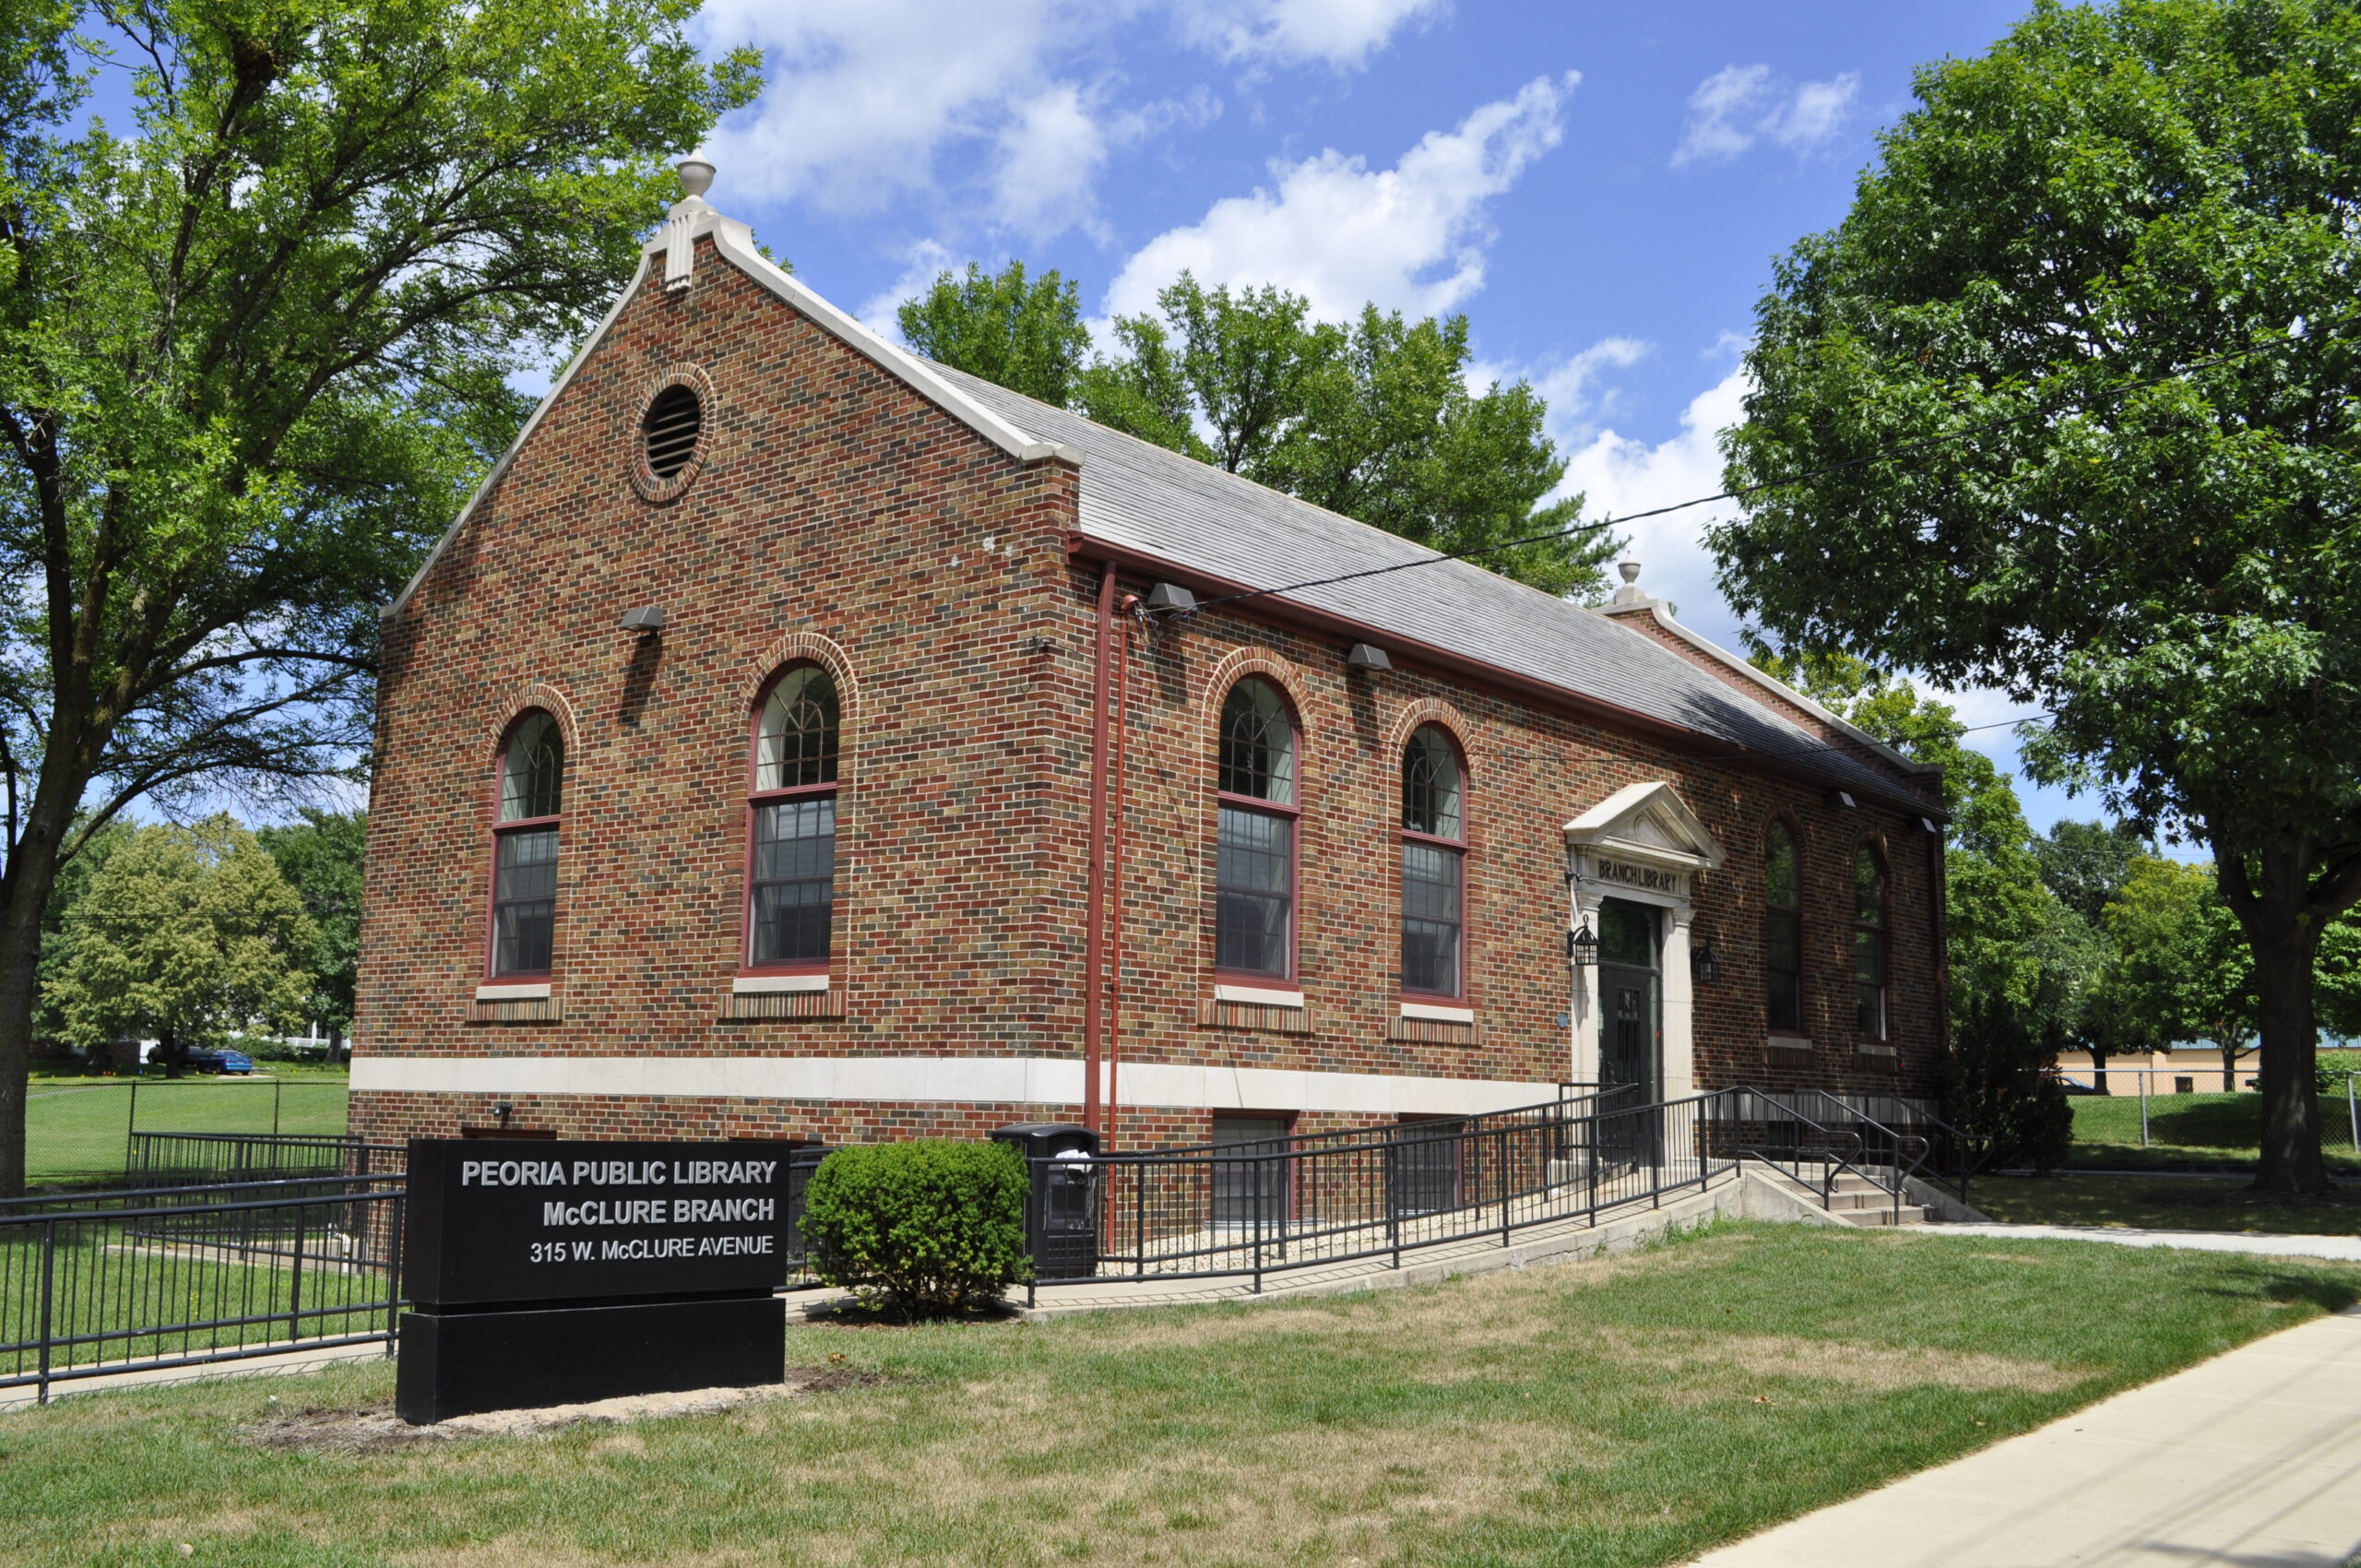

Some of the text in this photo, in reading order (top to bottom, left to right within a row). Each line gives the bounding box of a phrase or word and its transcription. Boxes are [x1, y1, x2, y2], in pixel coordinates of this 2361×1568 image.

[1598, 860, 1677, 893] BRANCH LIBRARY
[462, 1160, 777, 1187] PEORIA PUBLIC LIBRARY
[543, 1198, 776, 1227] McCLURE BRANCH
[529, 1235, 775, 1264] 315 W. McCLURE AVENUE
